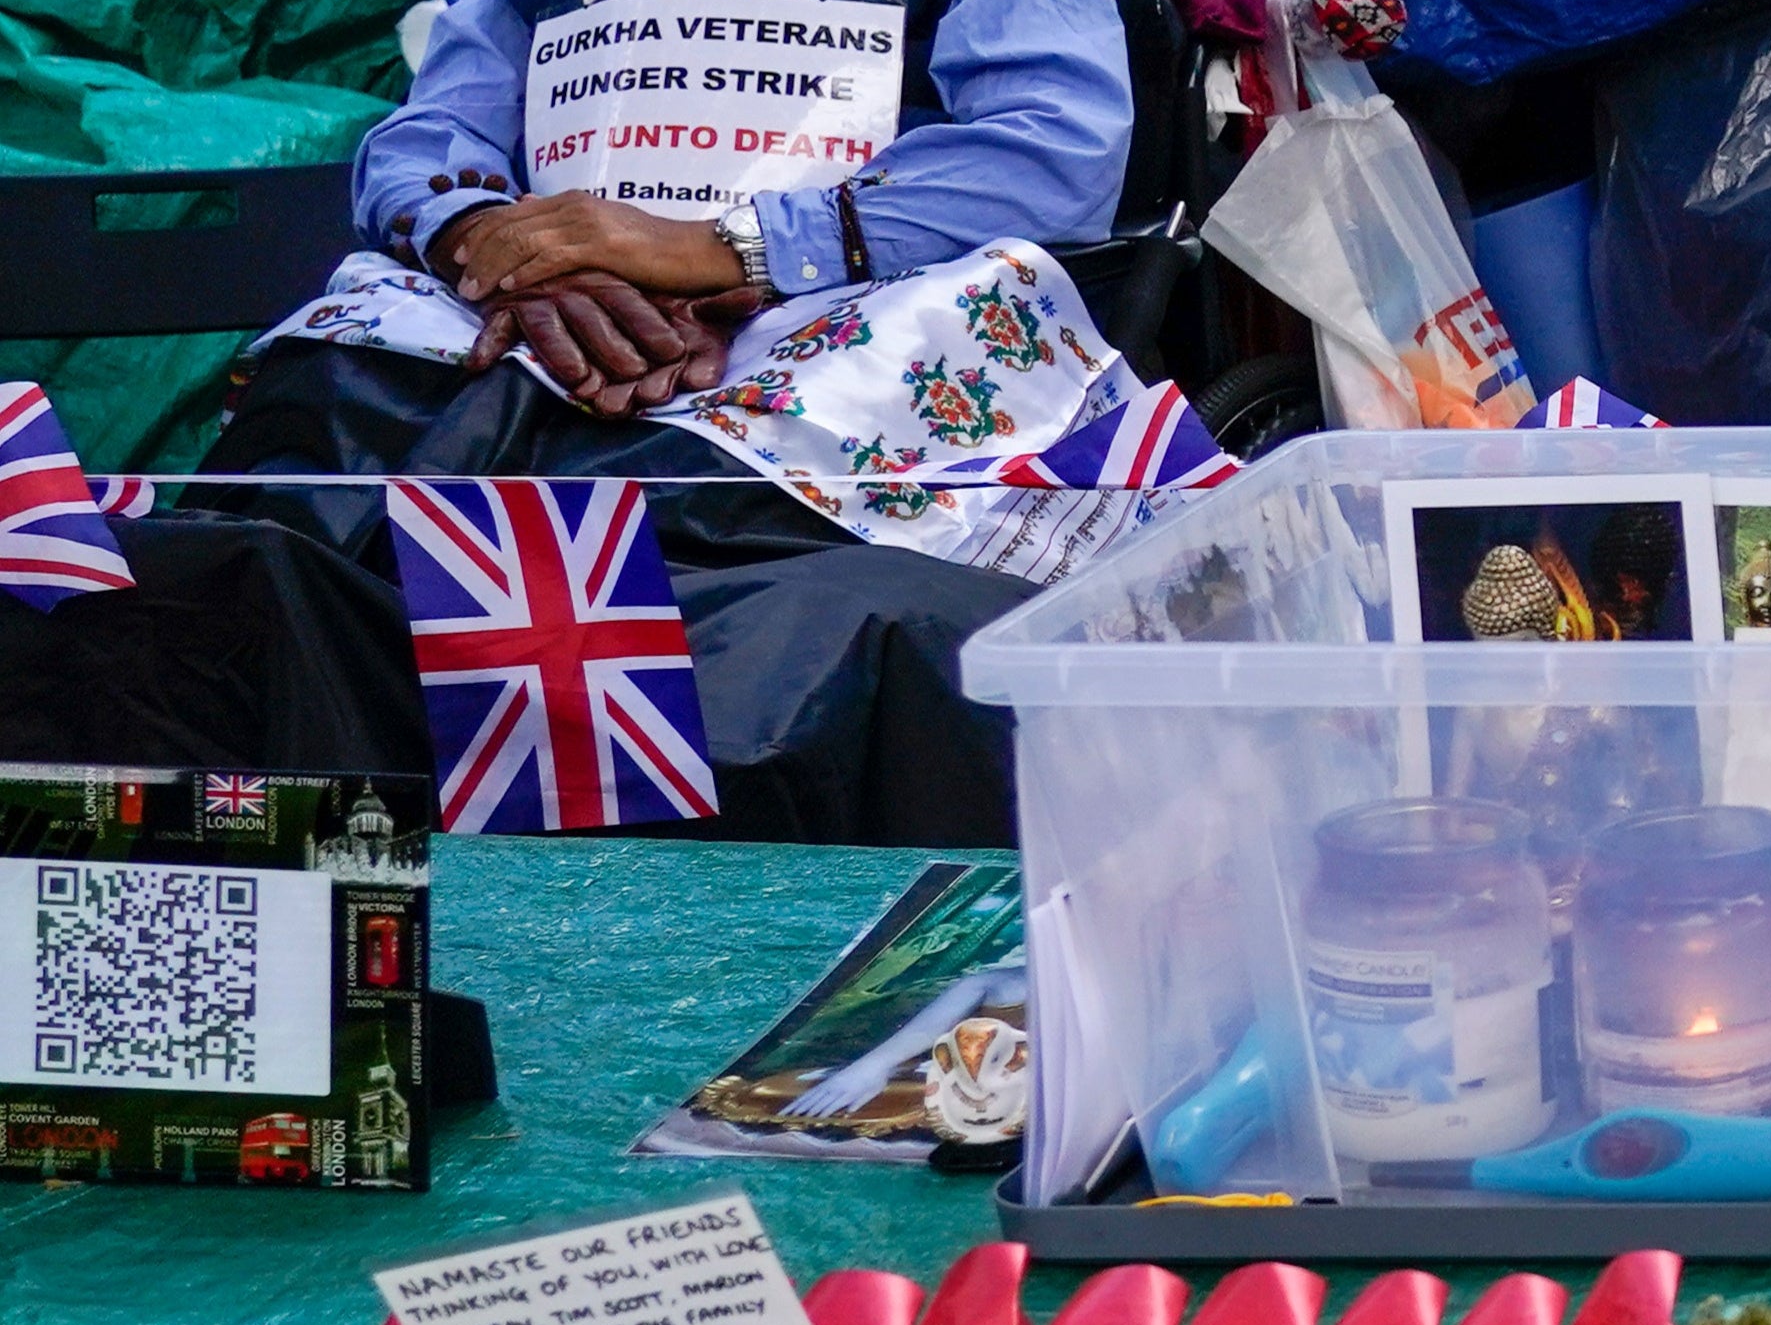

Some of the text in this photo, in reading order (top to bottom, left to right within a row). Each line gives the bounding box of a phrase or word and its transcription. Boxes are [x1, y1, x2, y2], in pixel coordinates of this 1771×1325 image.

[535, 17, 894, 65] GURKHA VETERANS
[549, 66, 855, 108] HUNGER STRIKE
[534, 124, 874, 173] FAST UNTO DEATH
[616, 181, 746, 206] Bahadur
[85, 766, 98, 822] LONDON
[267, 776, 331, 788] BOND STREET
[205, 815, 266, 831] LONDON
[357, 903, 405, 914] VICTORIA
[347, 944, 358, 987] LONDON
[347, 999, 385, 1009] LONDON
[9, 1114, 100, 1126] COVENT GARDEN
[163, 1125, 239, 1137] HOLLAND PARK
[331, 1119, 346, 1187] LONDON
[398, 1206, 744, 1300] NAMASTE OUR FRIENDS
[405, 1285, 530, 1324] THINKING
[541, 1274, 569, 1296] OF
[649, 1248, 710, 1272] WITH
[549, 1305, 596, 1324] TIM
[682, 1271, 765, 1297] MARION
[685, 1297, 766, 1325] FAMILY
